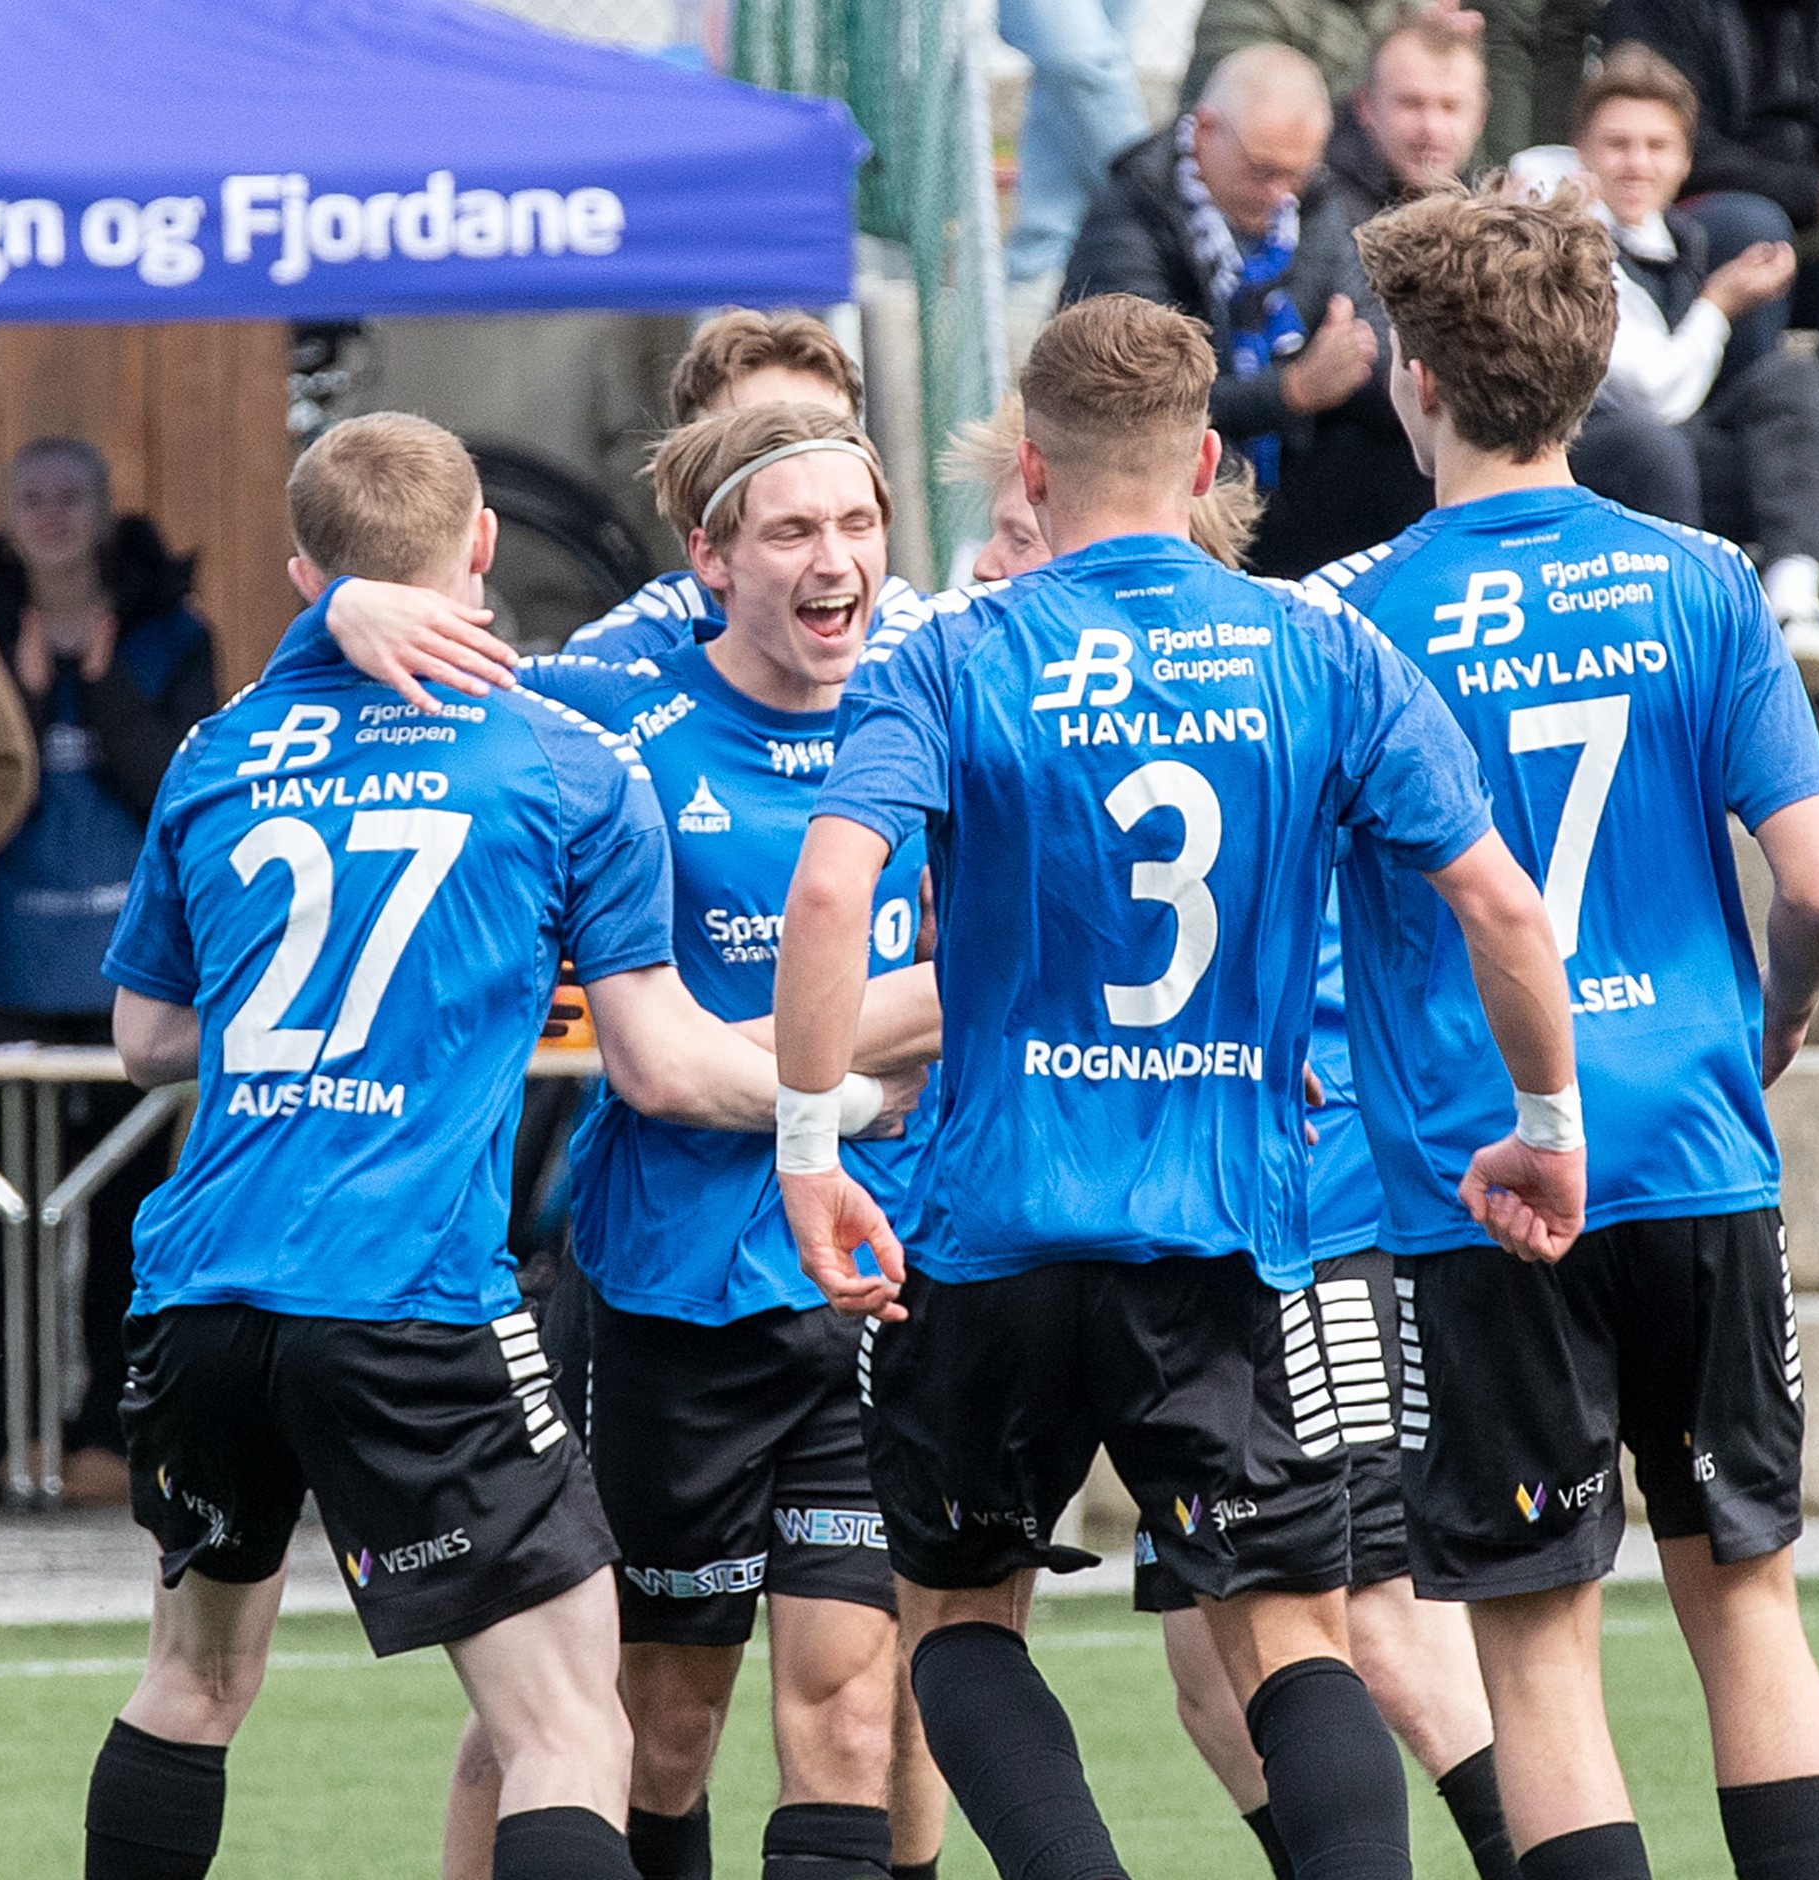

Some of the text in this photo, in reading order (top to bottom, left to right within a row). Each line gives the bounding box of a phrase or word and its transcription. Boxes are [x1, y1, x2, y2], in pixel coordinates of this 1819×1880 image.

[80, 193, 205, 287] og
[221, 170, 626, 285] Fjordane
[1541, 551, 1669, 588] Fjord Base
[1547, 583, 1653, 614] Gruppen
[1148, 623, 1271, 655] Fjord Base
[1153, 657, 1254, 684] Gruppen
[1456, 640, 1667, 696] HAVLAND
[424, 704, 487, 723] ase
[1059, 708, 1268, 747] HAVLAND
[355, 726, 456, 745] Gruppen
[250, 770, 449, 809] HAVLAND
[1509, 693, 1630, 960] 7
[1103, 760, 1222, 1027] 3
[223, 808, 472, 1074] 27
[379, 1527, 471, 1574] VESTNES
